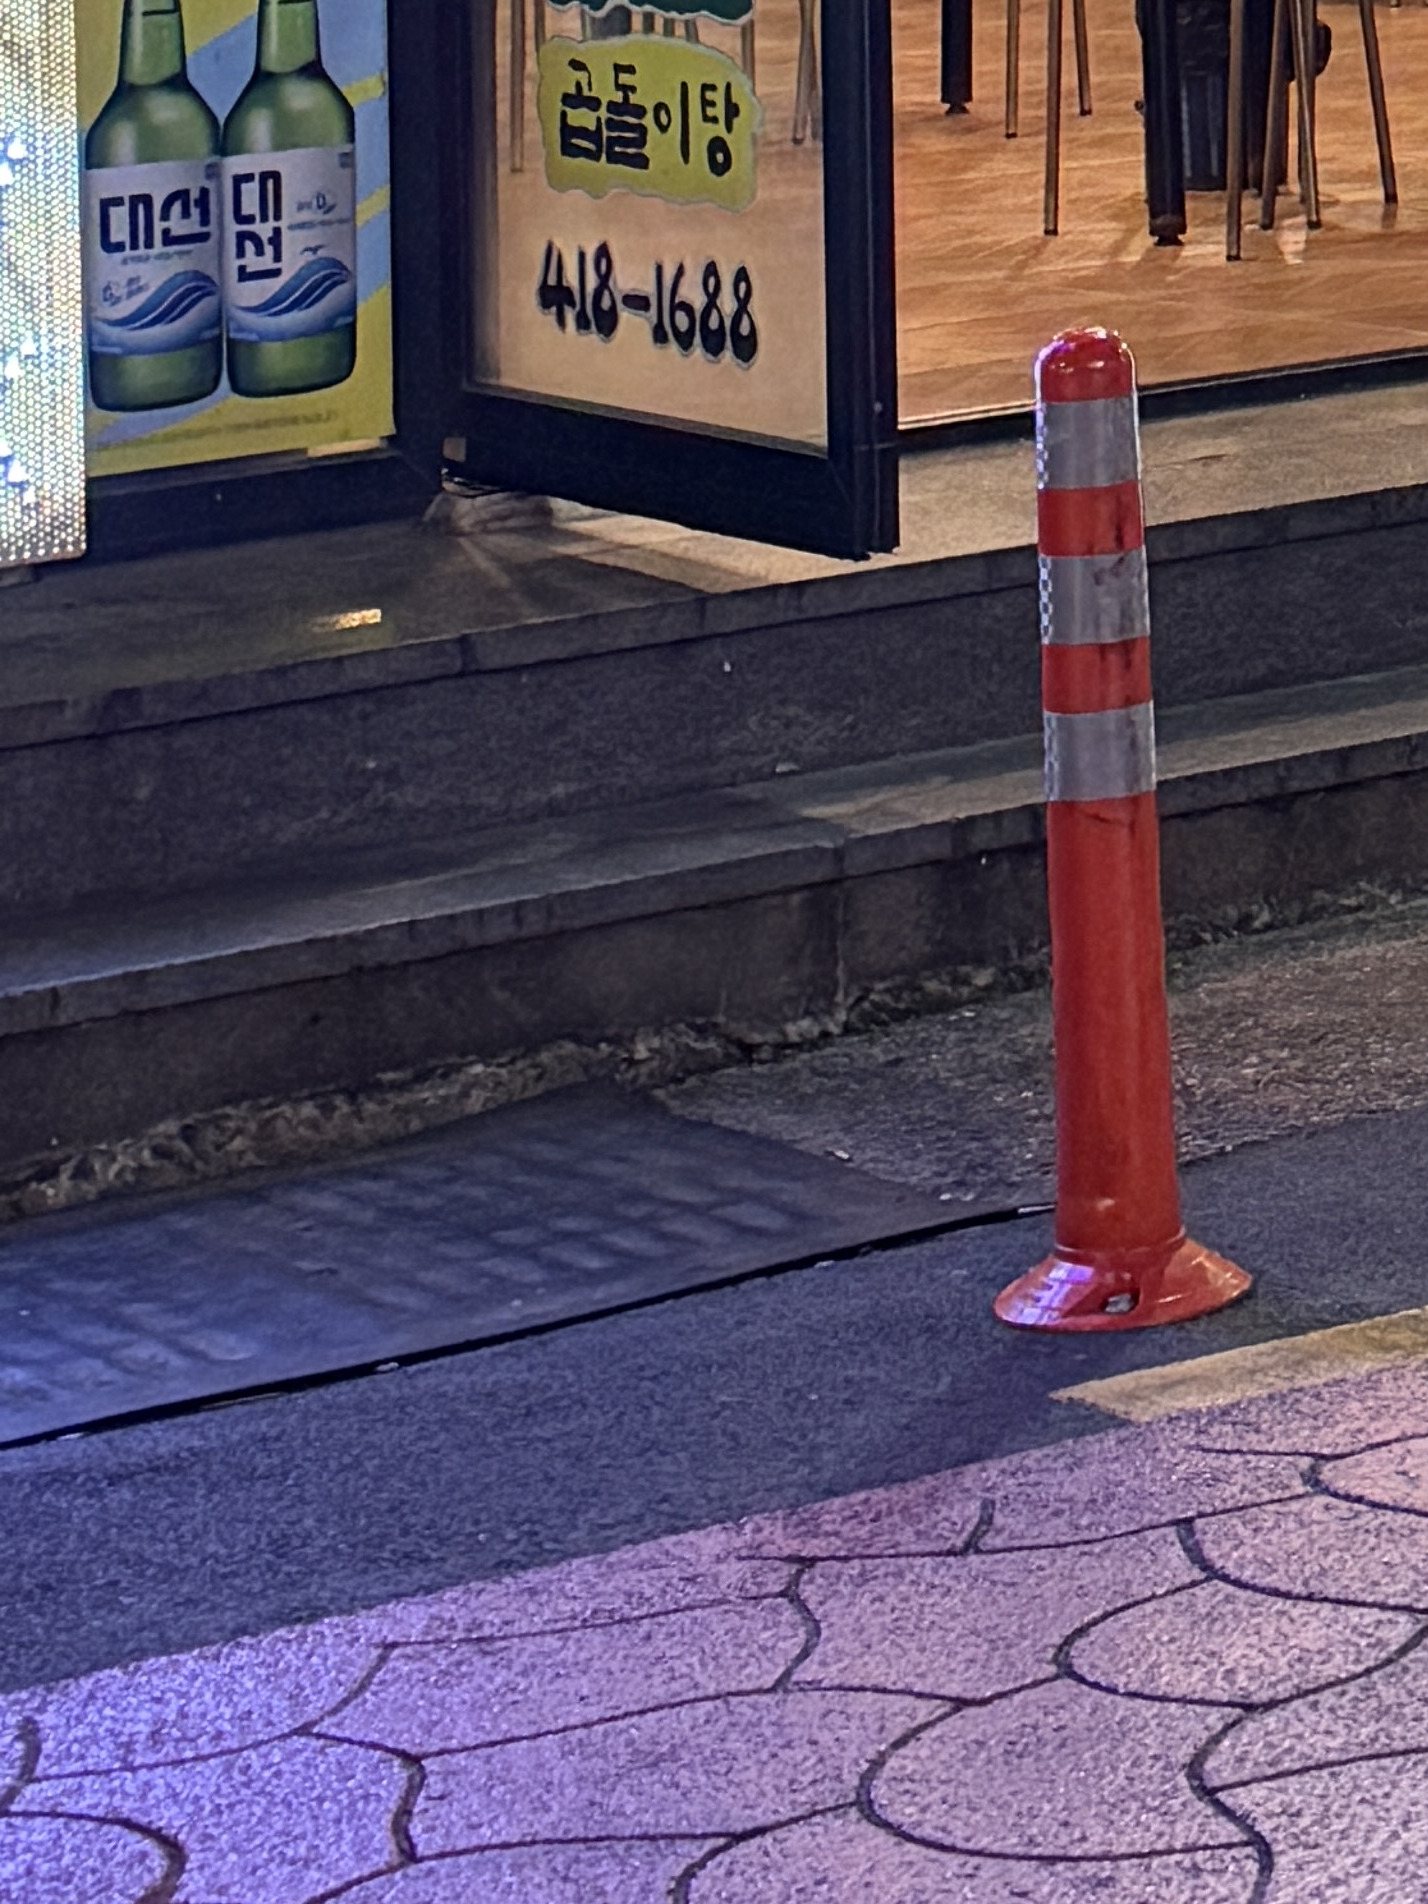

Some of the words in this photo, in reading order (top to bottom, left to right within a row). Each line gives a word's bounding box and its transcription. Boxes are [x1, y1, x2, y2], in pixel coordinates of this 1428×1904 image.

[559, 58, 741, 177] 곱돌이탕
[100, 185, 211, 254] 대선
[232, 169, 283, 283] 대선
[536, 239, 759, 368] 418-1688
